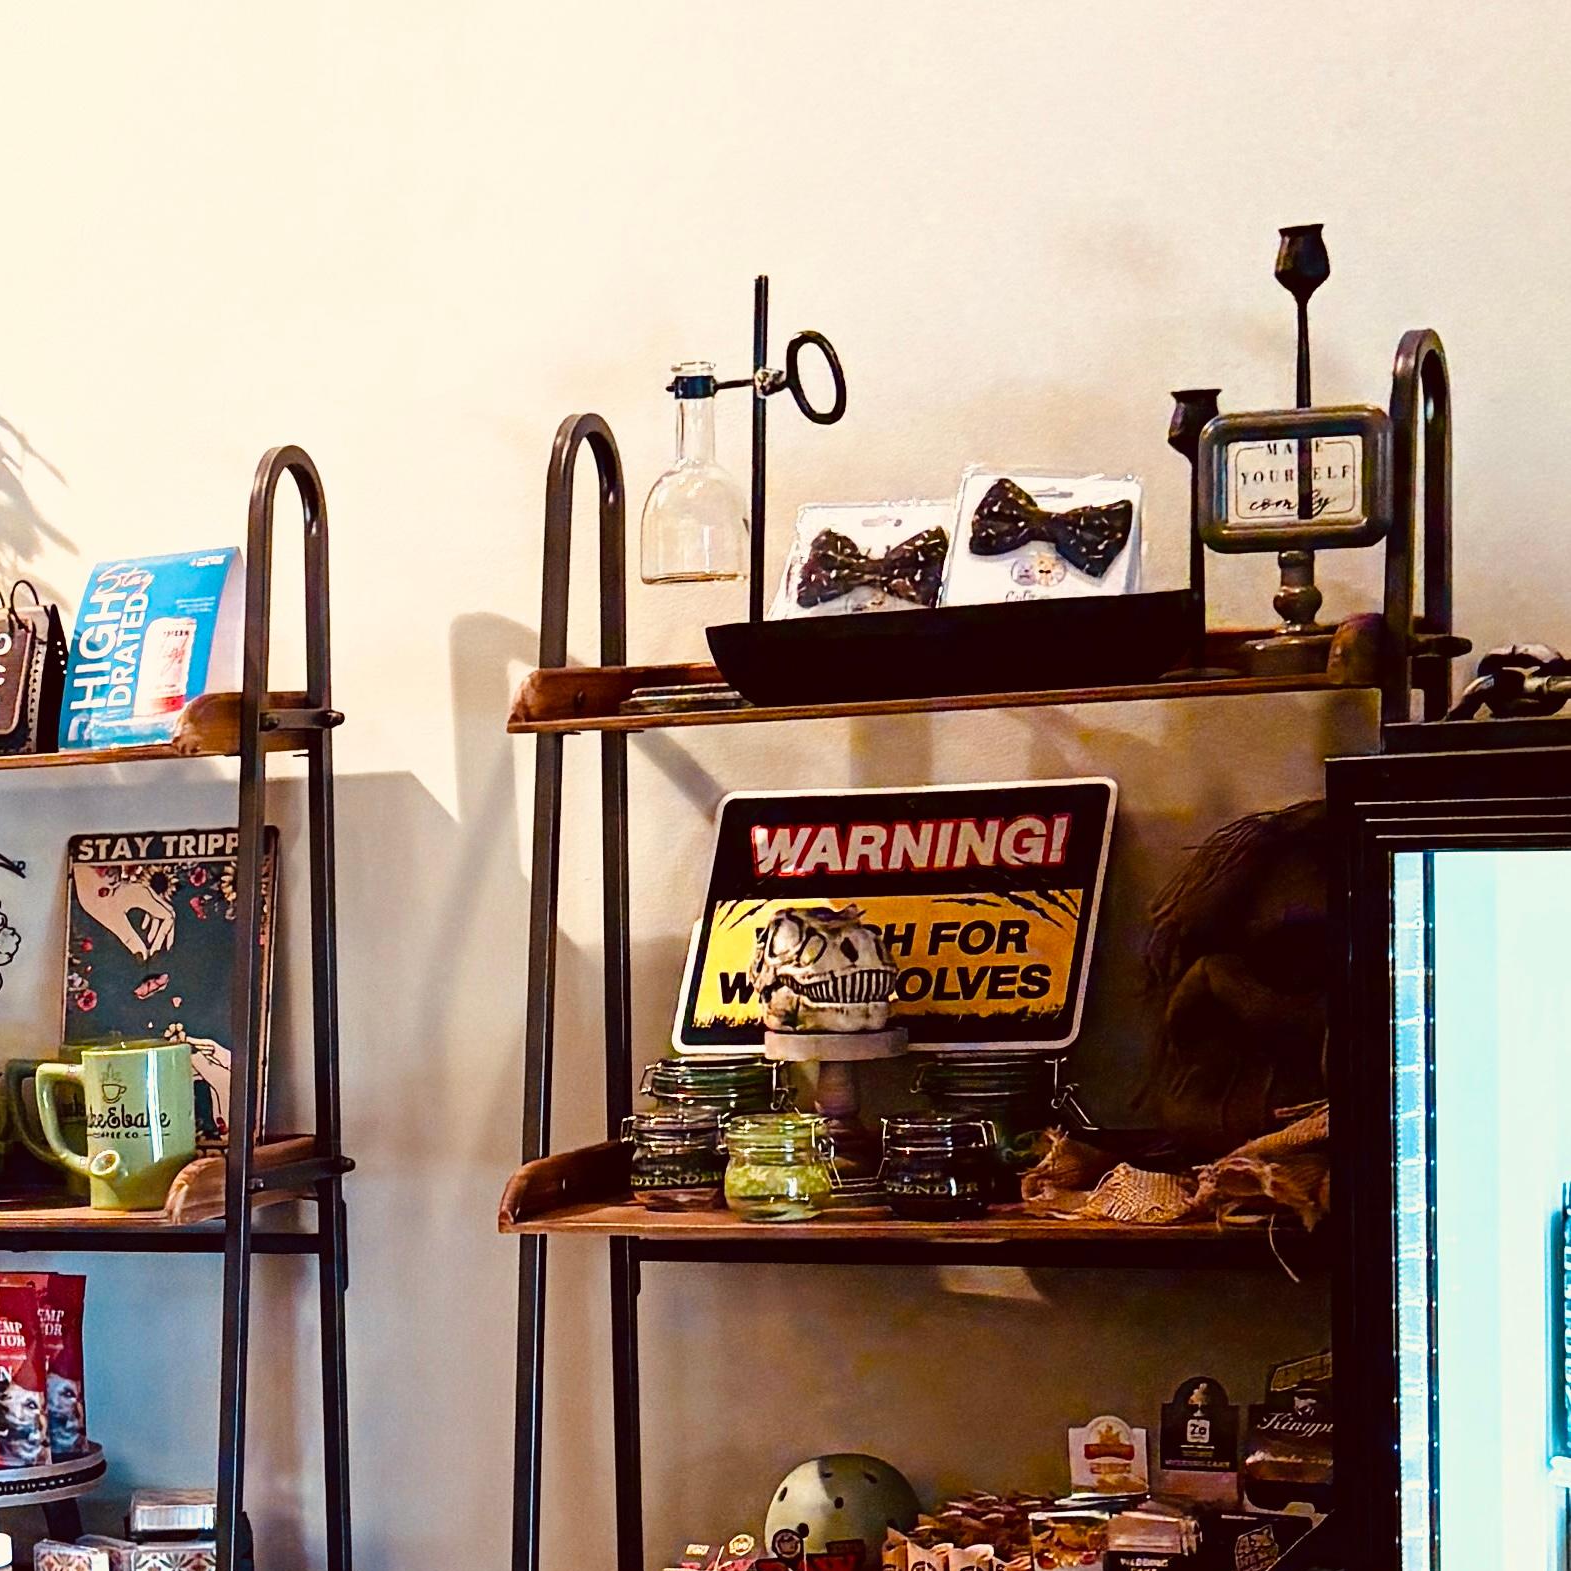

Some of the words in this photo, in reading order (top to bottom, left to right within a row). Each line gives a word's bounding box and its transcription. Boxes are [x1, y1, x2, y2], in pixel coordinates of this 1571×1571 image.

[1267, 440, 1323, 455] MAE
[1241, 465, 1350, 485] YOURELF
[1250, 488, 1336, 519] comy
[70, 591, 127, 710] HIGH
[78, 836, 154, 861] STAY
[162, 833, 239, 857] TRIPP
[753, 815, 1069, 876] WARNING!
[929, 920, 1029, 957] FOR
[720, 964, 1051, 1005] WOLVES
[1257, 1412, 1334, 1438] Kingpi
